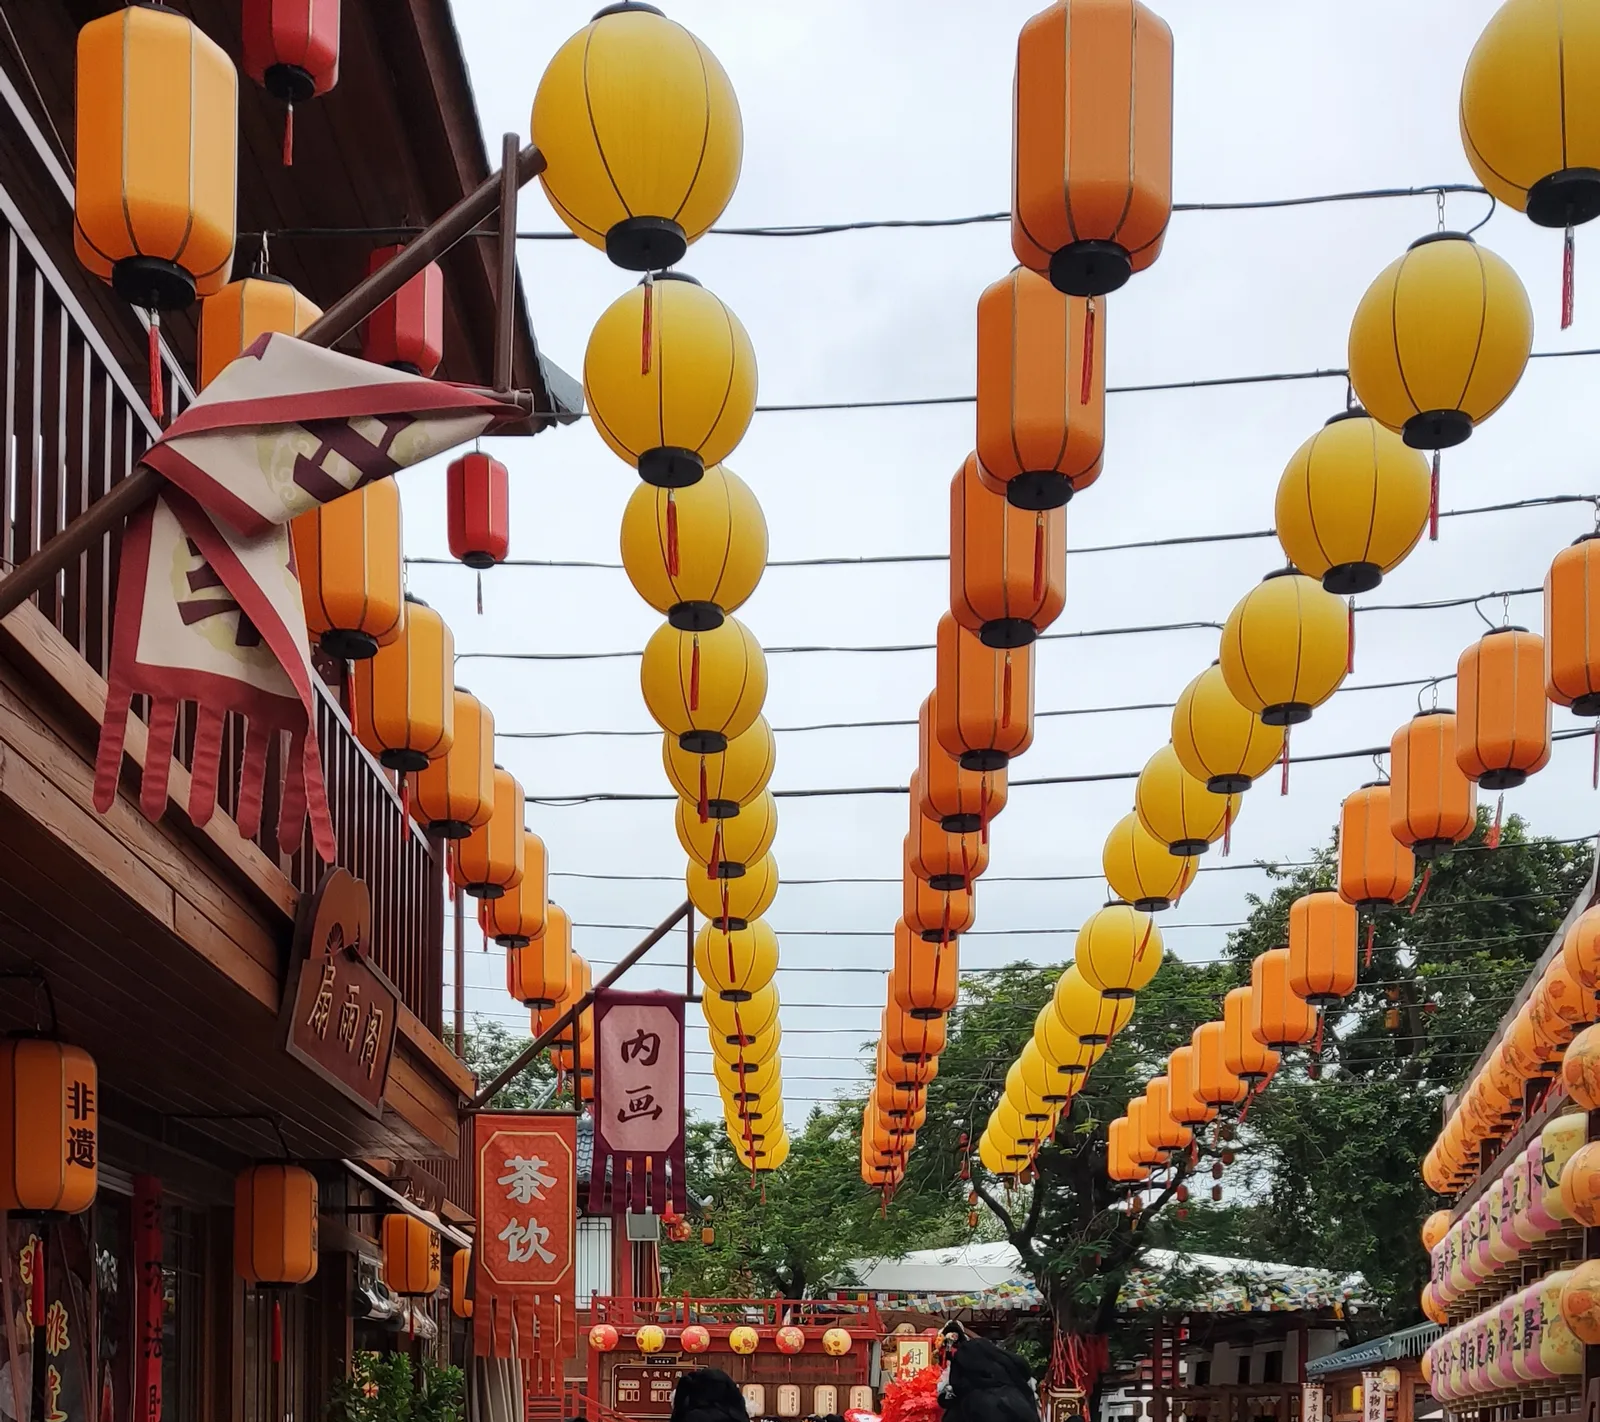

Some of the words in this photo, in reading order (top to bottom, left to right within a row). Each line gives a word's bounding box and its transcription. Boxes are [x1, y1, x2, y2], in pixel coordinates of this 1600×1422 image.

[617, 1029, 662, 1123] 内画
[66, 1080, 95, 1169] 非遗
[497, 1155, 557, 1263] 茶饮
